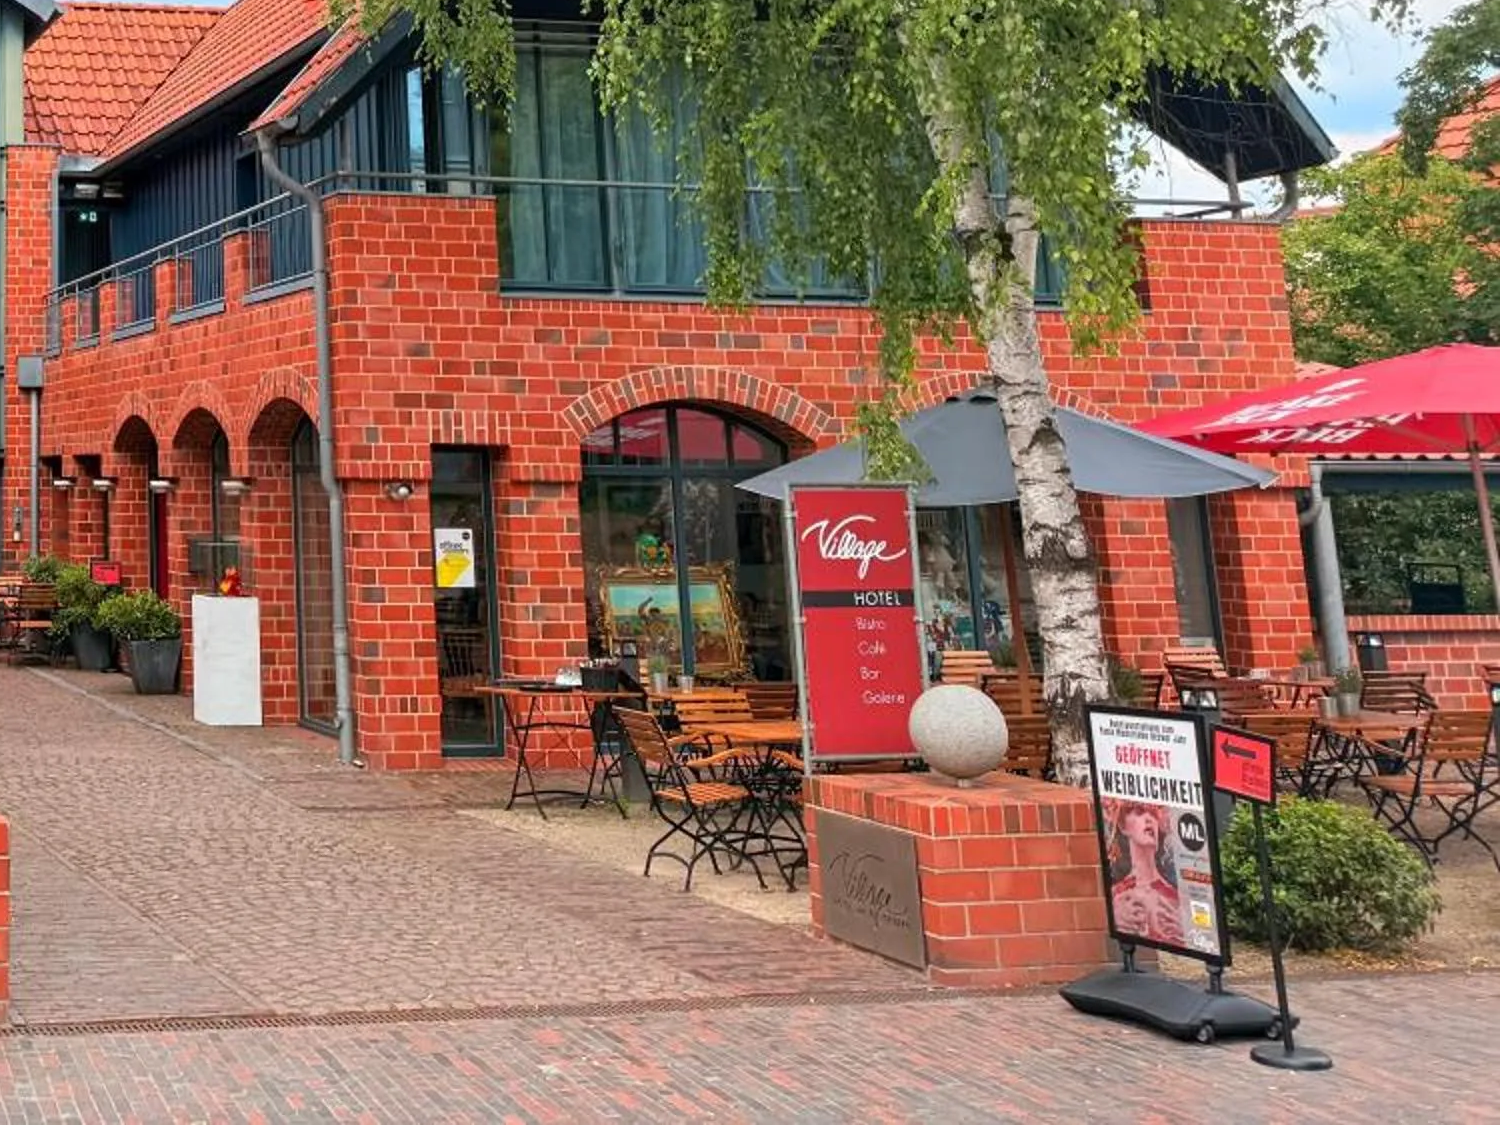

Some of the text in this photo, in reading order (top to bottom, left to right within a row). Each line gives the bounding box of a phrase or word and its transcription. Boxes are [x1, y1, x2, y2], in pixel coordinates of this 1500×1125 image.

[801, 514, 907, 580] Village
[854, 590, 902, 607] HOTEL
[856, 617, 886, 630] Bistro
[859, 666, 881, 681] Bar
[861, 689, 905, 705] Galerie
[1115, 742, 1171, 770] GEÖFFNET
[1100, 769, 1204, 806] WEIBLICHKEIT
[1180, 821, 1205, 842] ML
